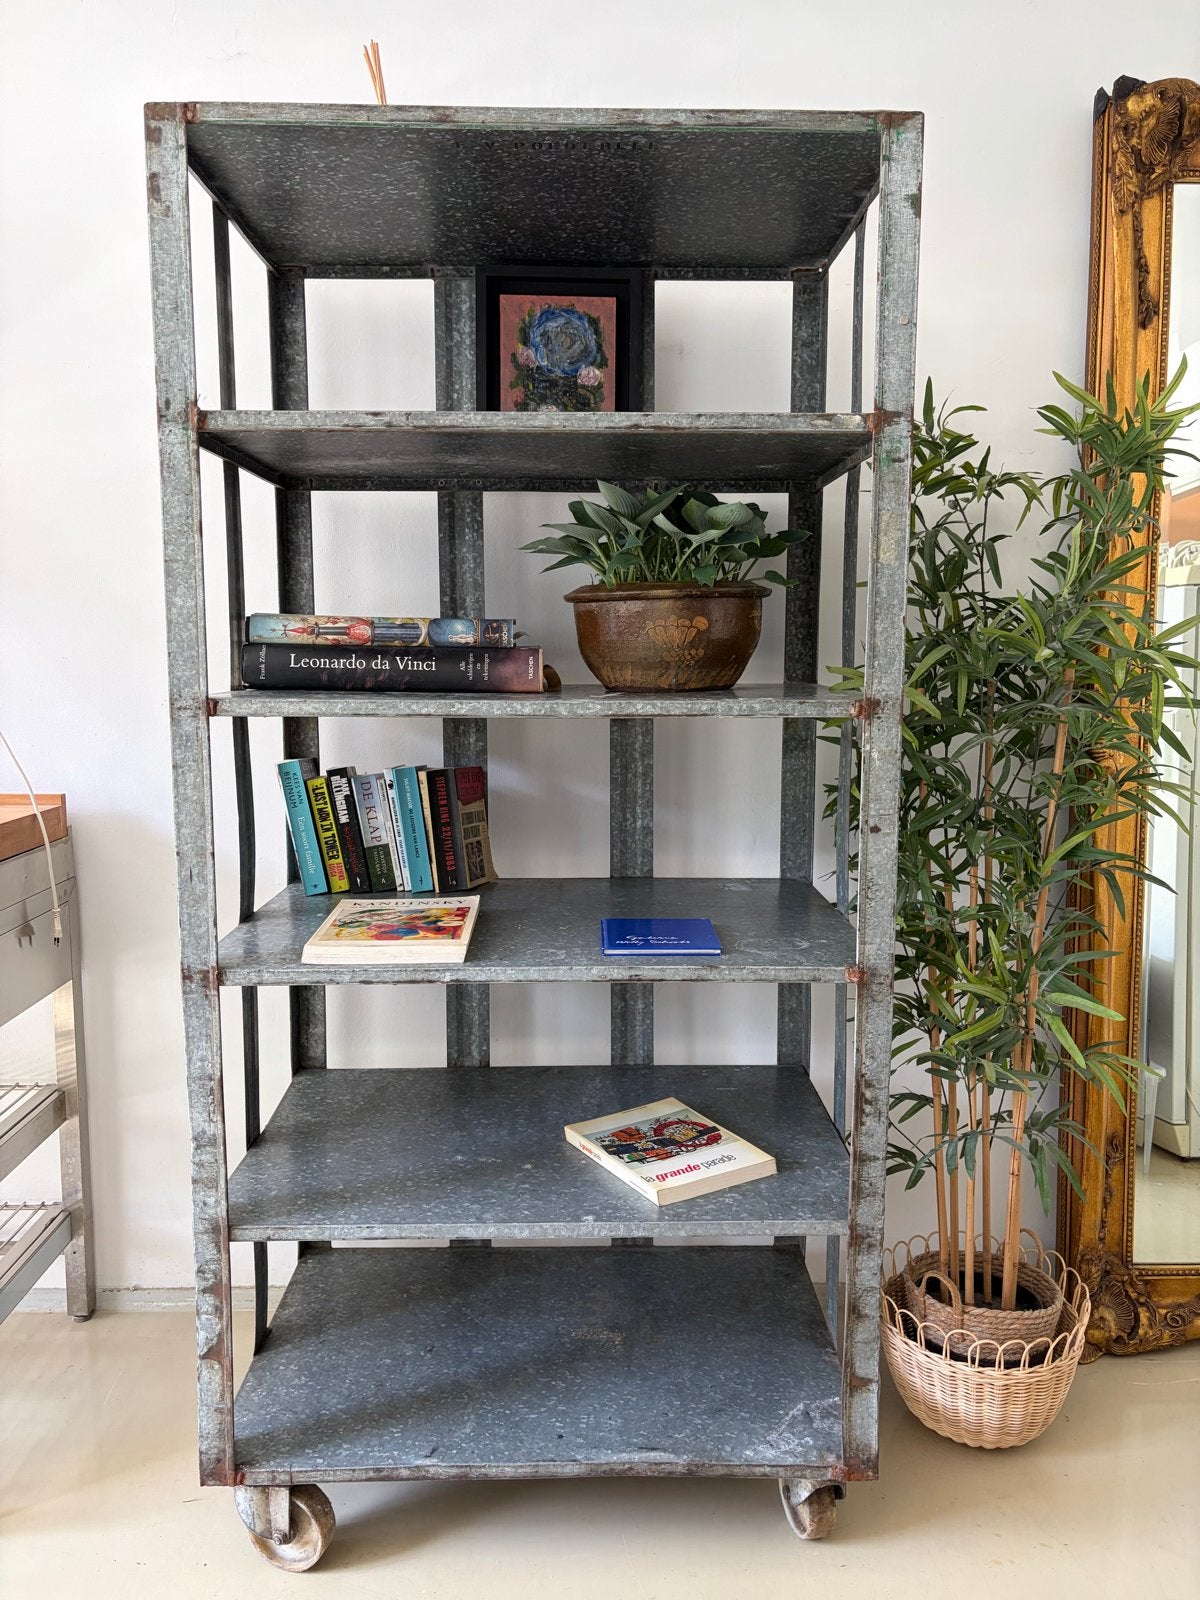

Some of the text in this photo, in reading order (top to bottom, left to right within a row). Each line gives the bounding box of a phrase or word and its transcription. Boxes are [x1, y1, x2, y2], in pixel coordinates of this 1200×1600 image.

[289, 653, 437, 671] Leonardo da Vinci
[284, 772, 297, 808] BEIJNUM
[312, 785, 327, 806] LAST
[330, 775, 350, 824] BILLINGHAM
[340, 777, 350, 796] MARK
[361, 780, 382, 843] DE KLAP
[437, 777, 455, 871] STEPHEN KING 22/11/1963
[302, 832, 310, 849] soort
[320, 823, 334, 833] IN
[324, 833, 340, 861] TOWER
[379, 847, 387, 874] CHRISTOS
[305, 850, 315, 874] familie
[642, 1153, 736, 1183] la grande parade
